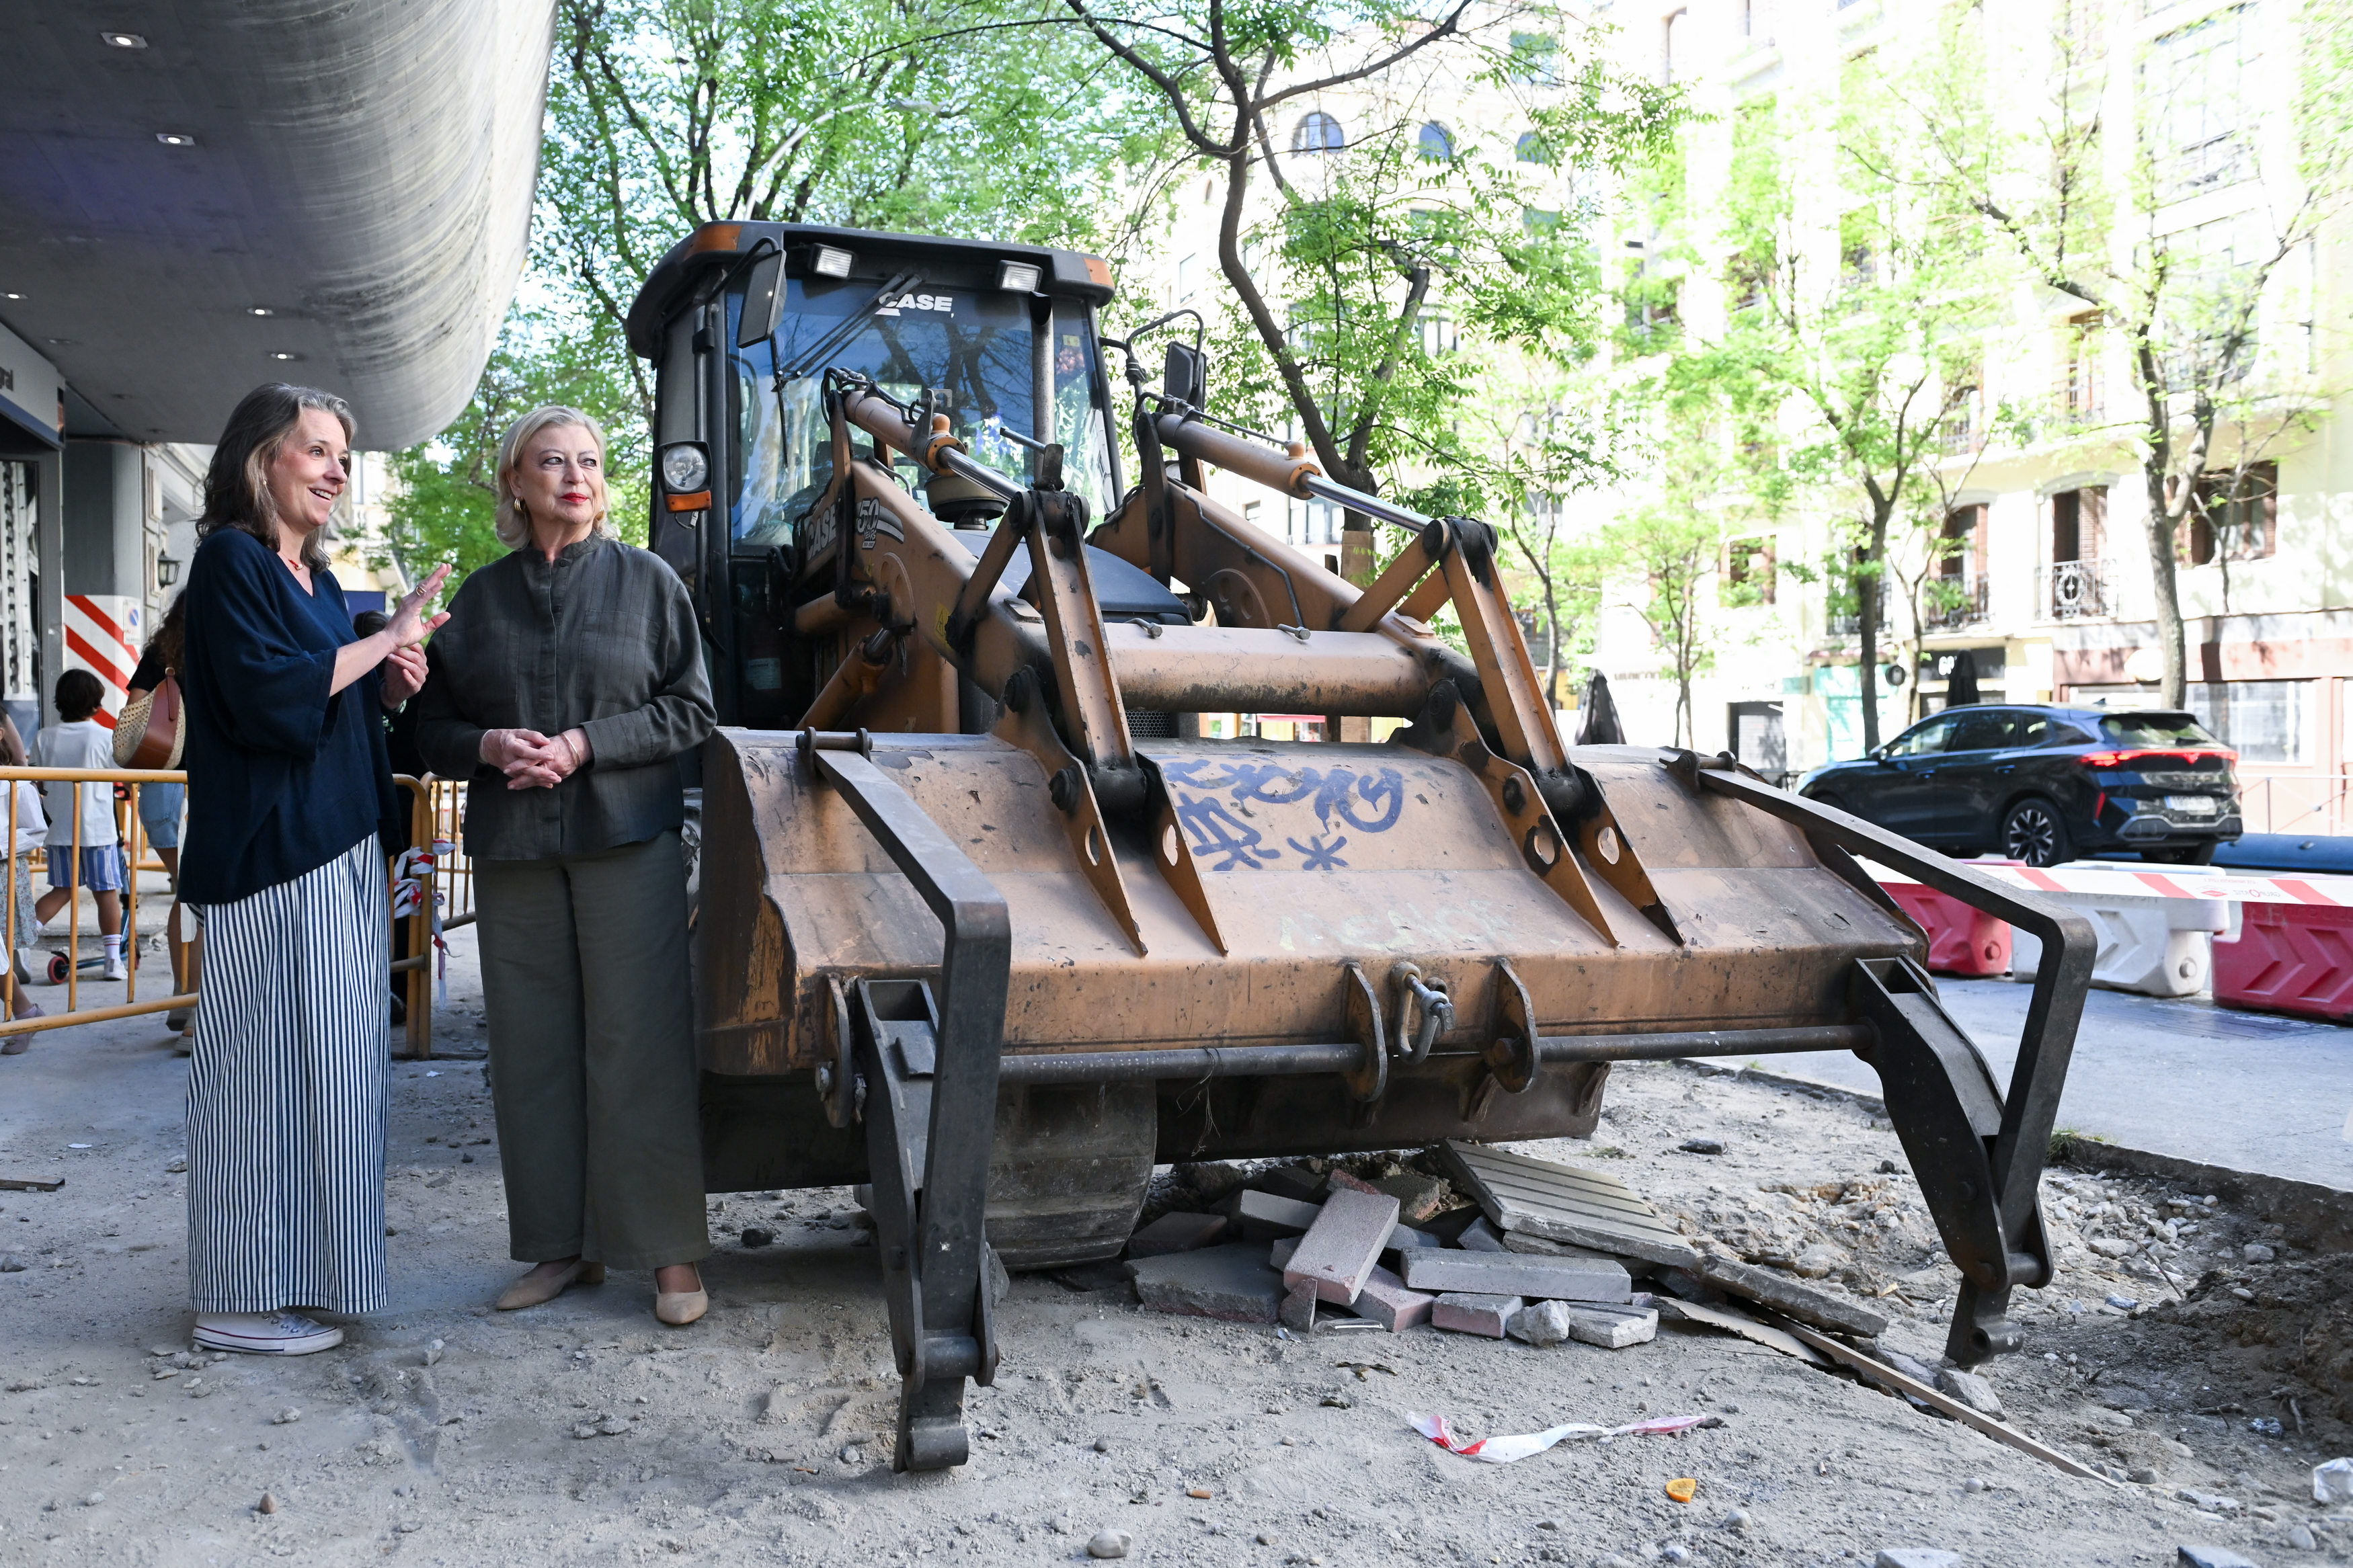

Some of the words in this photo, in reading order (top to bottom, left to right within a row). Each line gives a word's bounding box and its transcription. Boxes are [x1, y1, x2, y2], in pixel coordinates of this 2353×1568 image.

[879, 292, 953, 312] CASE
[807, 503, 836, 561] CASE
[857, 499, 879, 533] 50
